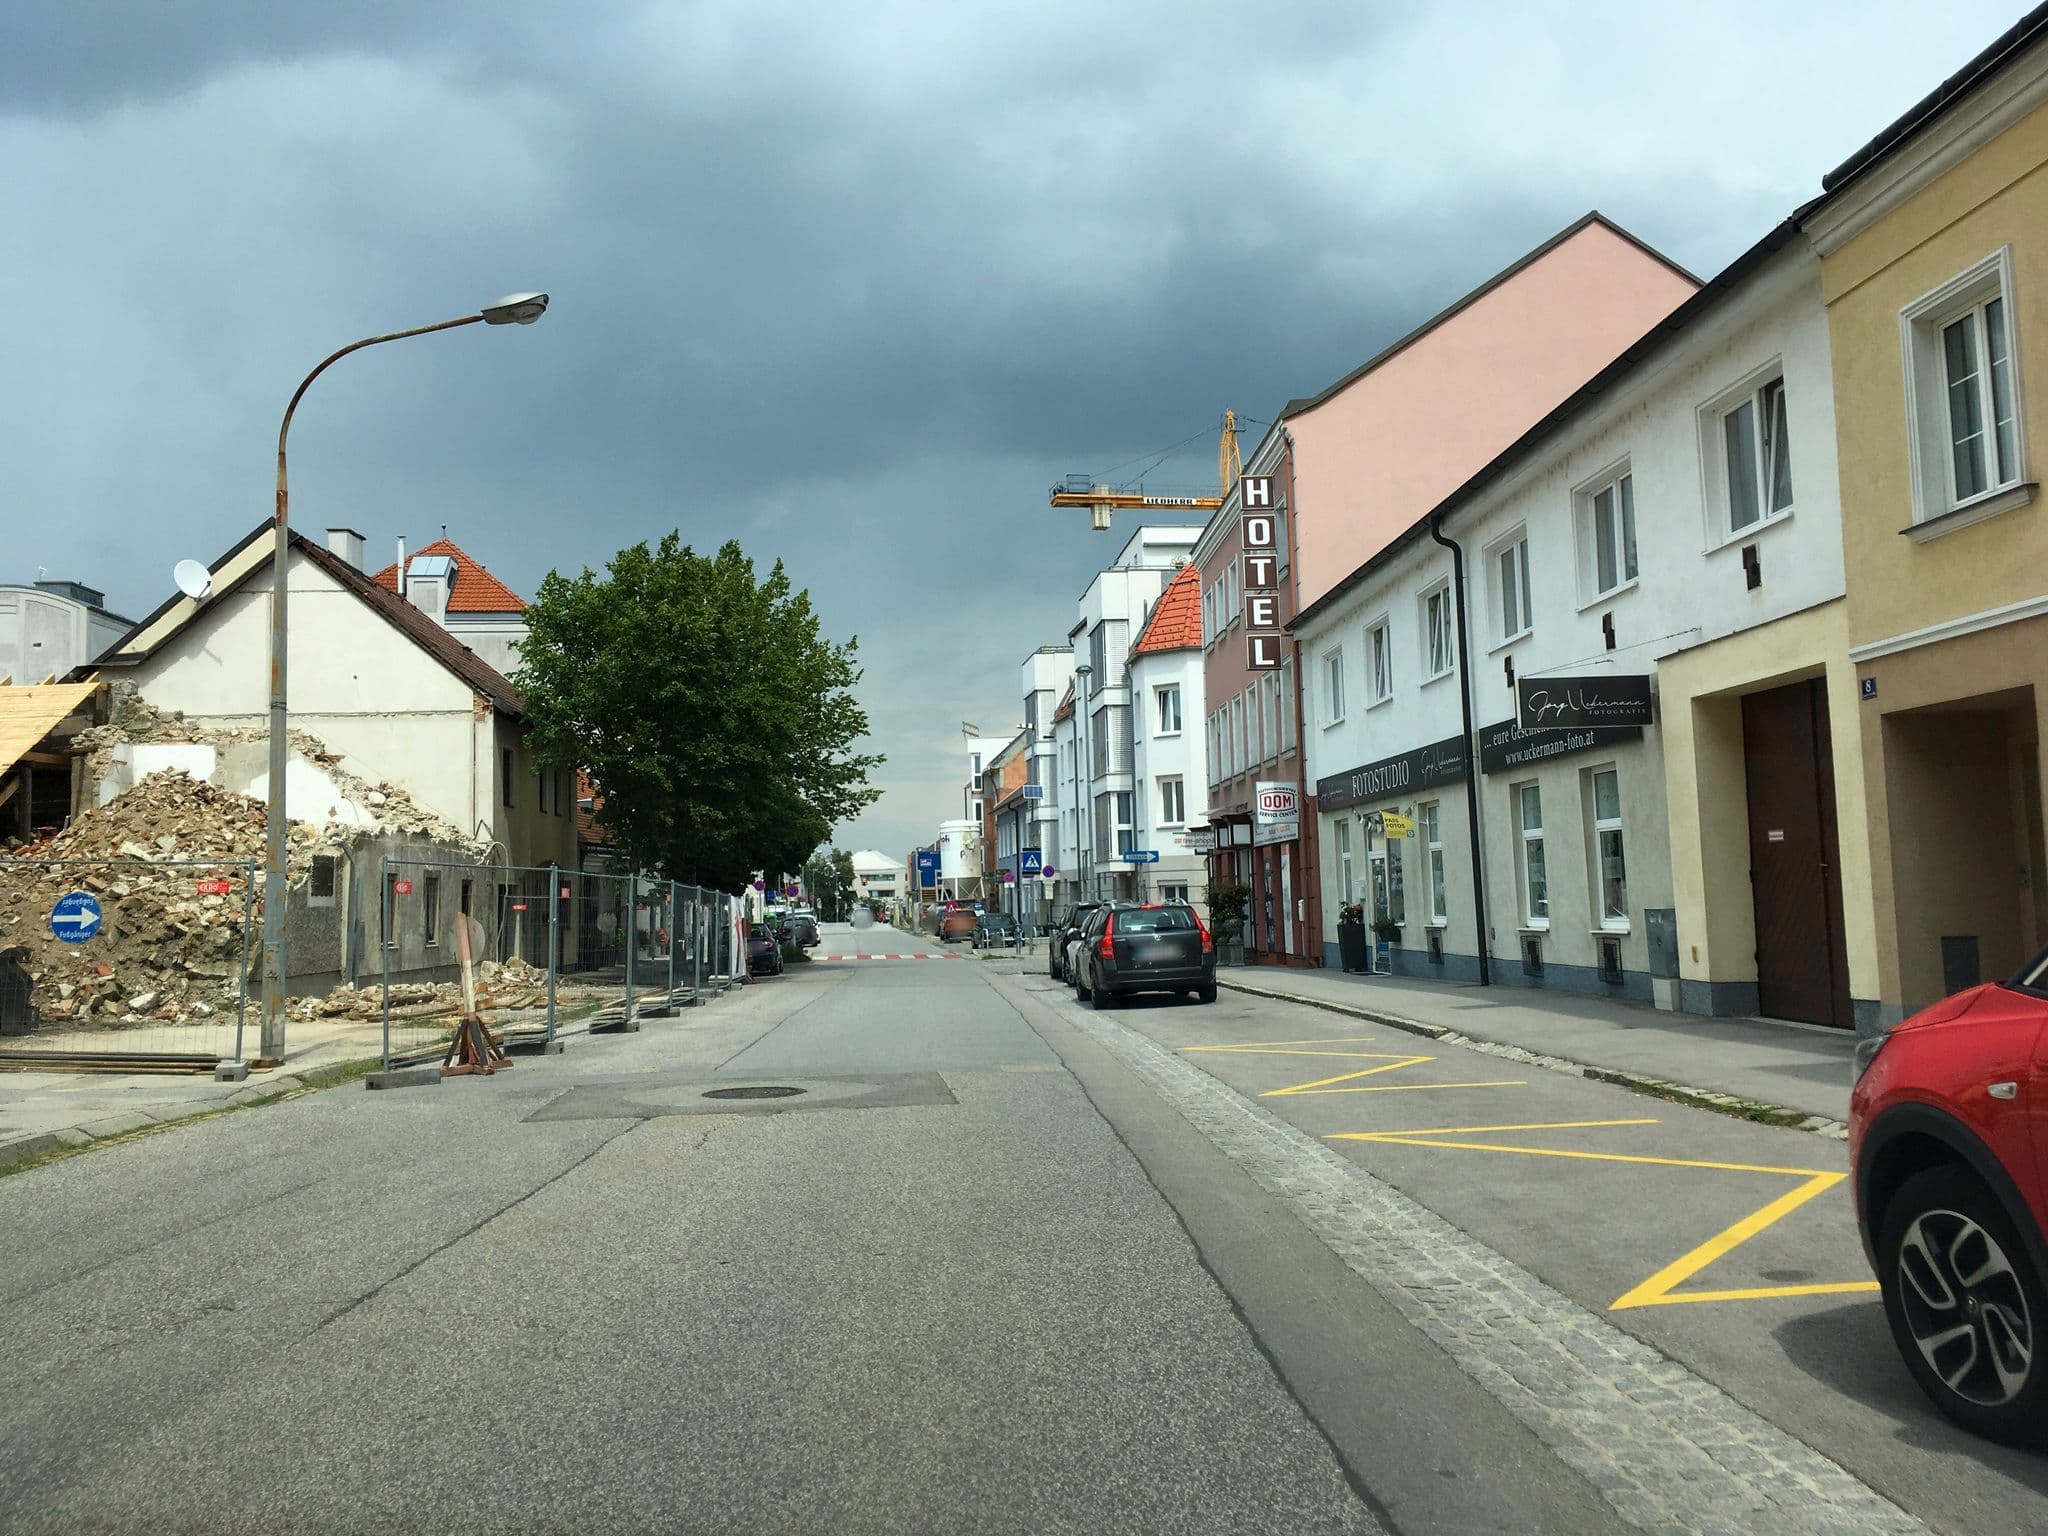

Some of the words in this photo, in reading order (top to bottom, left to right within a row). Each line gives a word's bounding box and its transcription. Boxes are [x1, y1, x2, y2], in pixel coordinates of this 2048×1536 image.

[1246, 478, 1275, 667] HOTEL
[1865, 680, 1872, 692] 8
[1589, 708, 1647, 716] FOTOGRAFIE
[1492, 730, 1509, 746] eure
[1505, 730, 1595, 765] www.uckermann-foto.at
[1351, 760, 1410, 798] FOTOSTUDIO
[1263, 795, 1292, 809] DOM
[1260, 810, 1278, 818] SERVICE
[1279, 809, 1298, 818] CENTER
